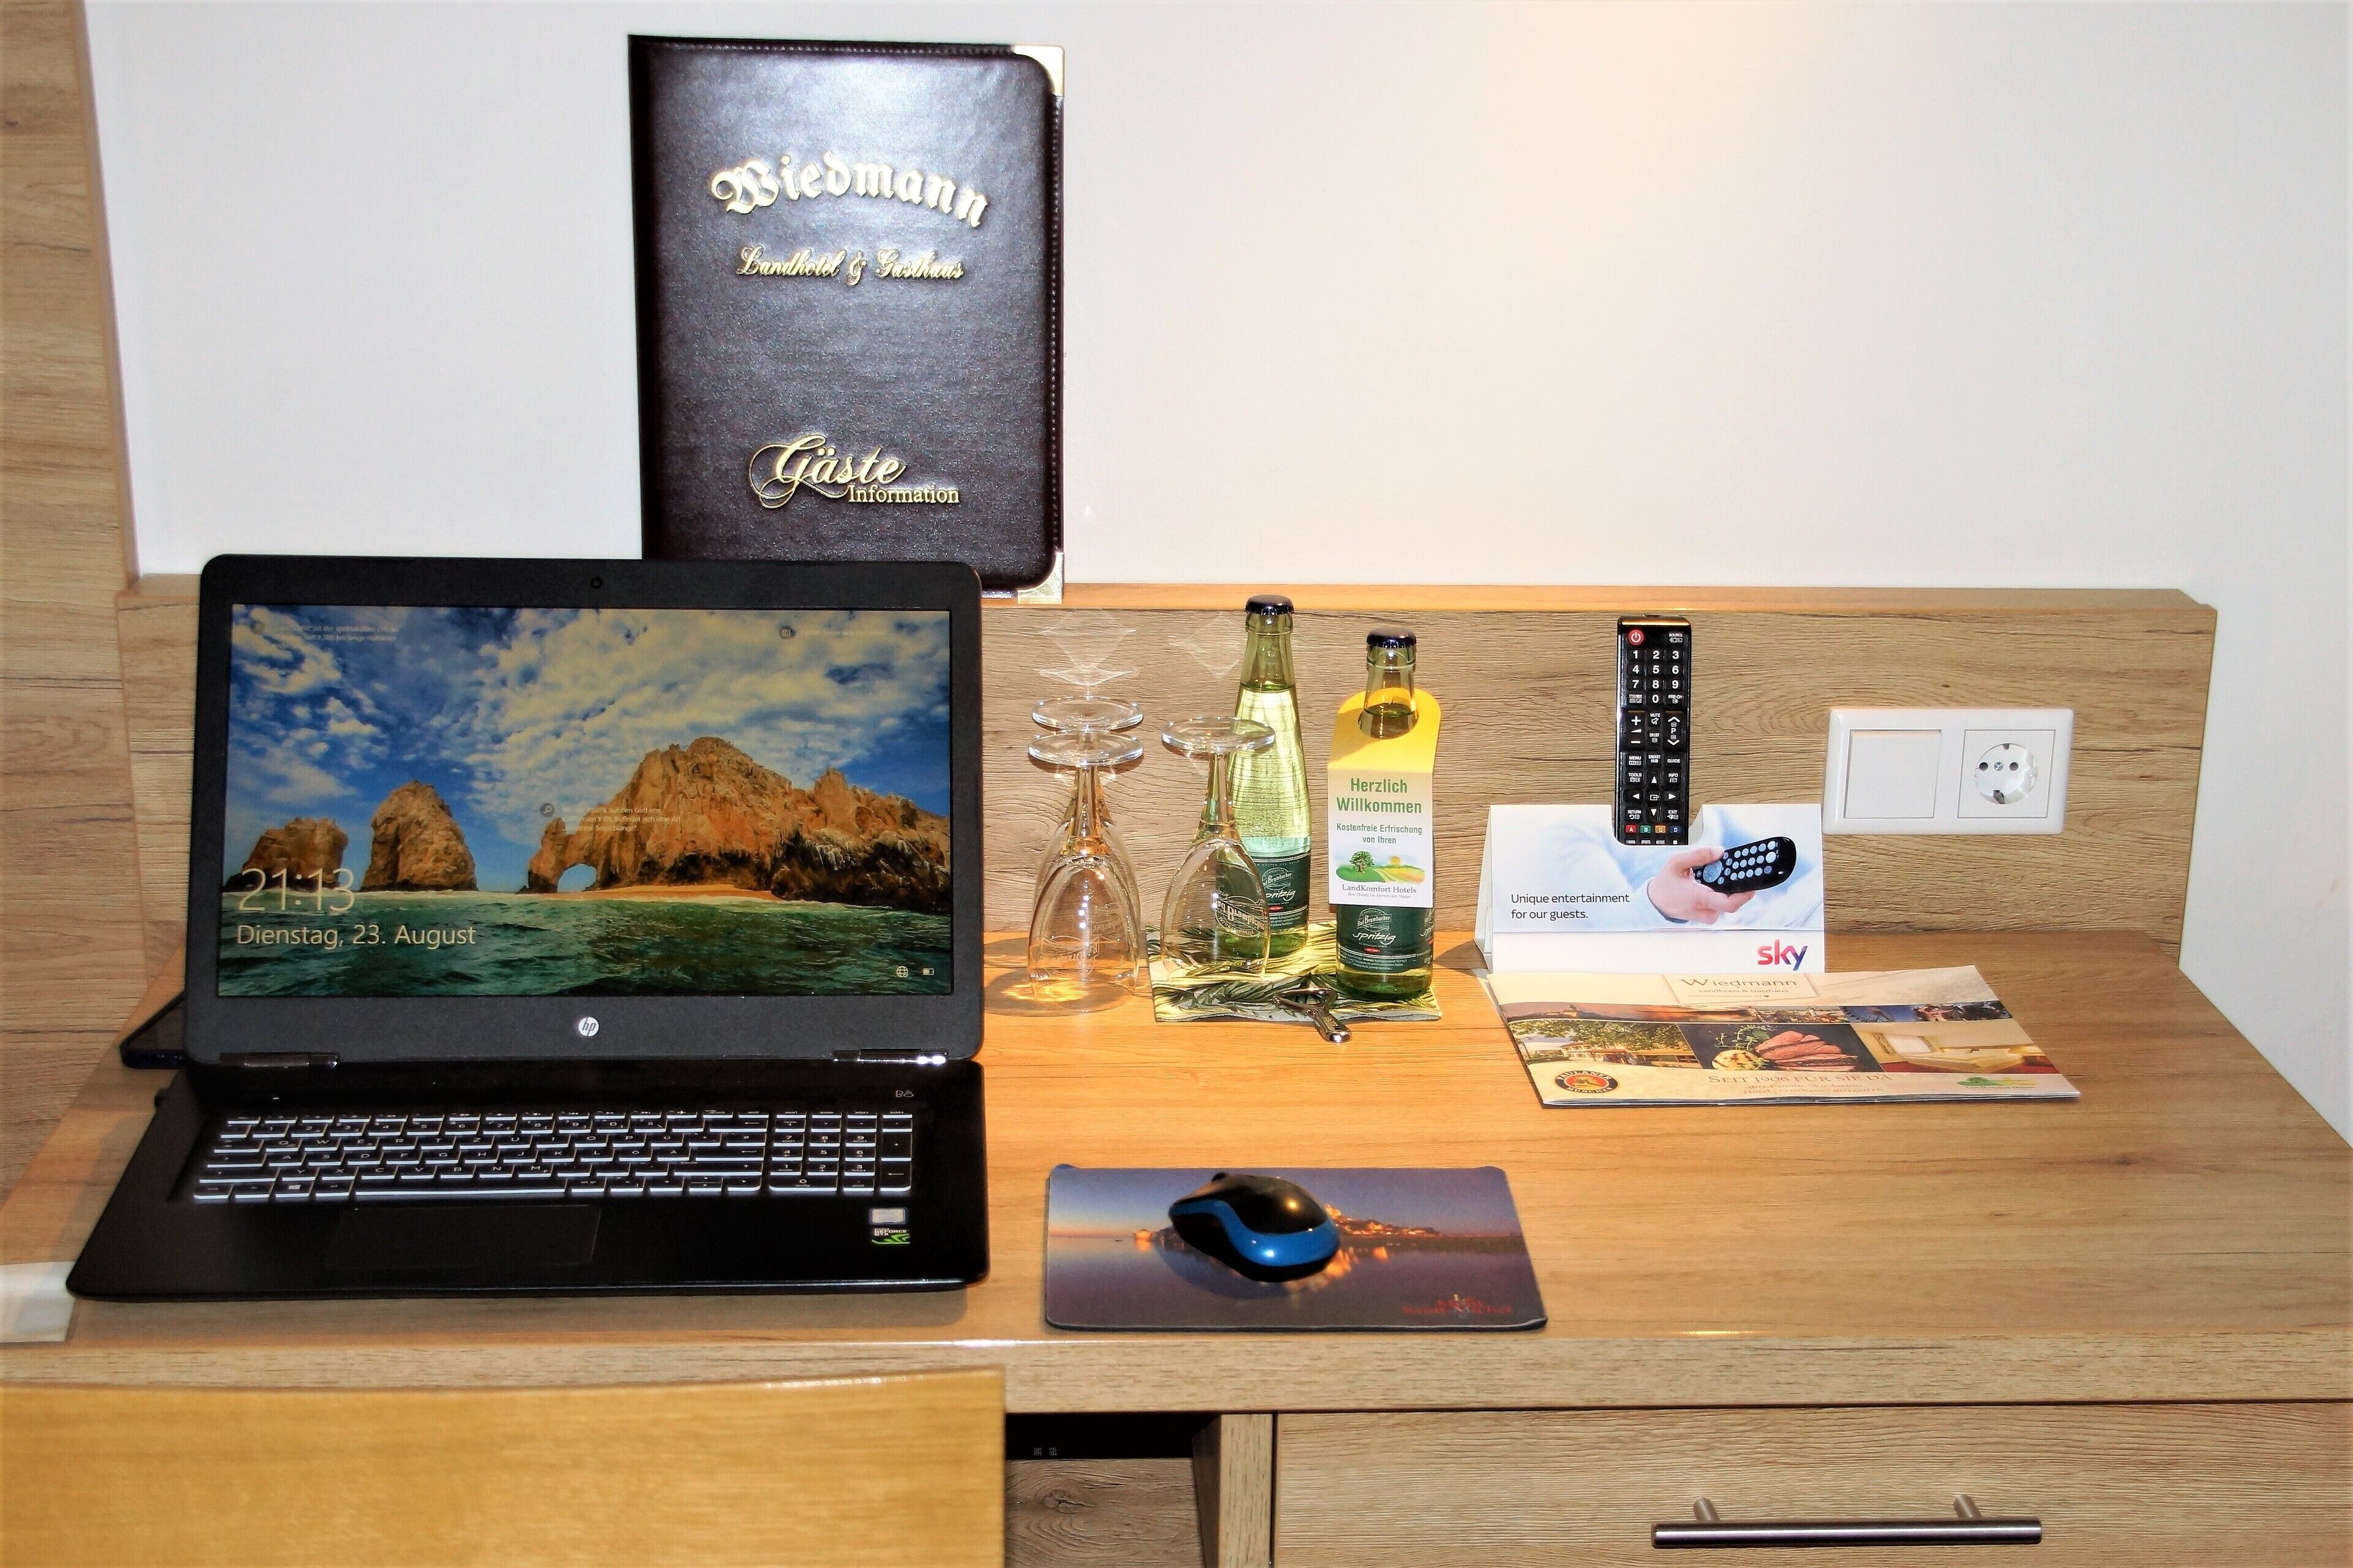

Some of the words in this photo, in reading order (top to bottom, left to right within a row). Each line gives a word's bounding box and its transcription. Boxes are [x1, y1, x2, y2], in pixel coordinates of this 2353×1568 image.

[711, 151, 990, 229] Wiedmann
[737, 244, 846, 278] Landhotel
[846, 250, 867, 286] &
[875, 248, 965, 281] Gasthaus
[749, 434, 906, 509] Gäste
[848, 483, 960, 504] Information
[1632, 651, 1638, 659] 1
[1653, 651, 1659, 659] 2
[1672, 651, 1679, 659] 3
[1632, 665, 1639, 674] 4
[1653, 665, 1659, 674] 5
[1672, 665, 1679, 674] 6
[1632, 680, 1639, 689] 7
[1652, 680, 1659, 689] 8
[1672, 680, 1679, 689] 9
[1652, 695, 1659, 703] 0
[1351, 778, 1408, 793] Herzlich
[1336, 797, 1422, 814] Willkommen
[1336, 823, 1377, 832] Kostenfreie
[1380, 824, 1422, 835] Erfrischung
[1377, 836, 1396, 844] Ihren
[1268, 873, 1292, 884] Brambacher
[240, 868, 355, 912] 21:13
[1342, 884, 1390, 893] LandKomfort
[1511, 893, 1550, 906] Unique
[1552, 893, 1630, 904] entertainment
[1365, 915, 1391, 924] Brambacher
[1511, 909, 1528, 919] for
[1529, 911, 1548, 919] our
[1550, 909, 1589, 921] guests.
[237, 925, 344, 950] Dienstag,
[352, 925, 385, 944] 23.
[394, 925, 476, 950] August
[1352, 932, 1396, 945] spritzig
[1757, 939, 1808, 971] sky
[581, 1017, 599, 1037] hp
[1556, 1070, 1612, 1080] PAULANER
